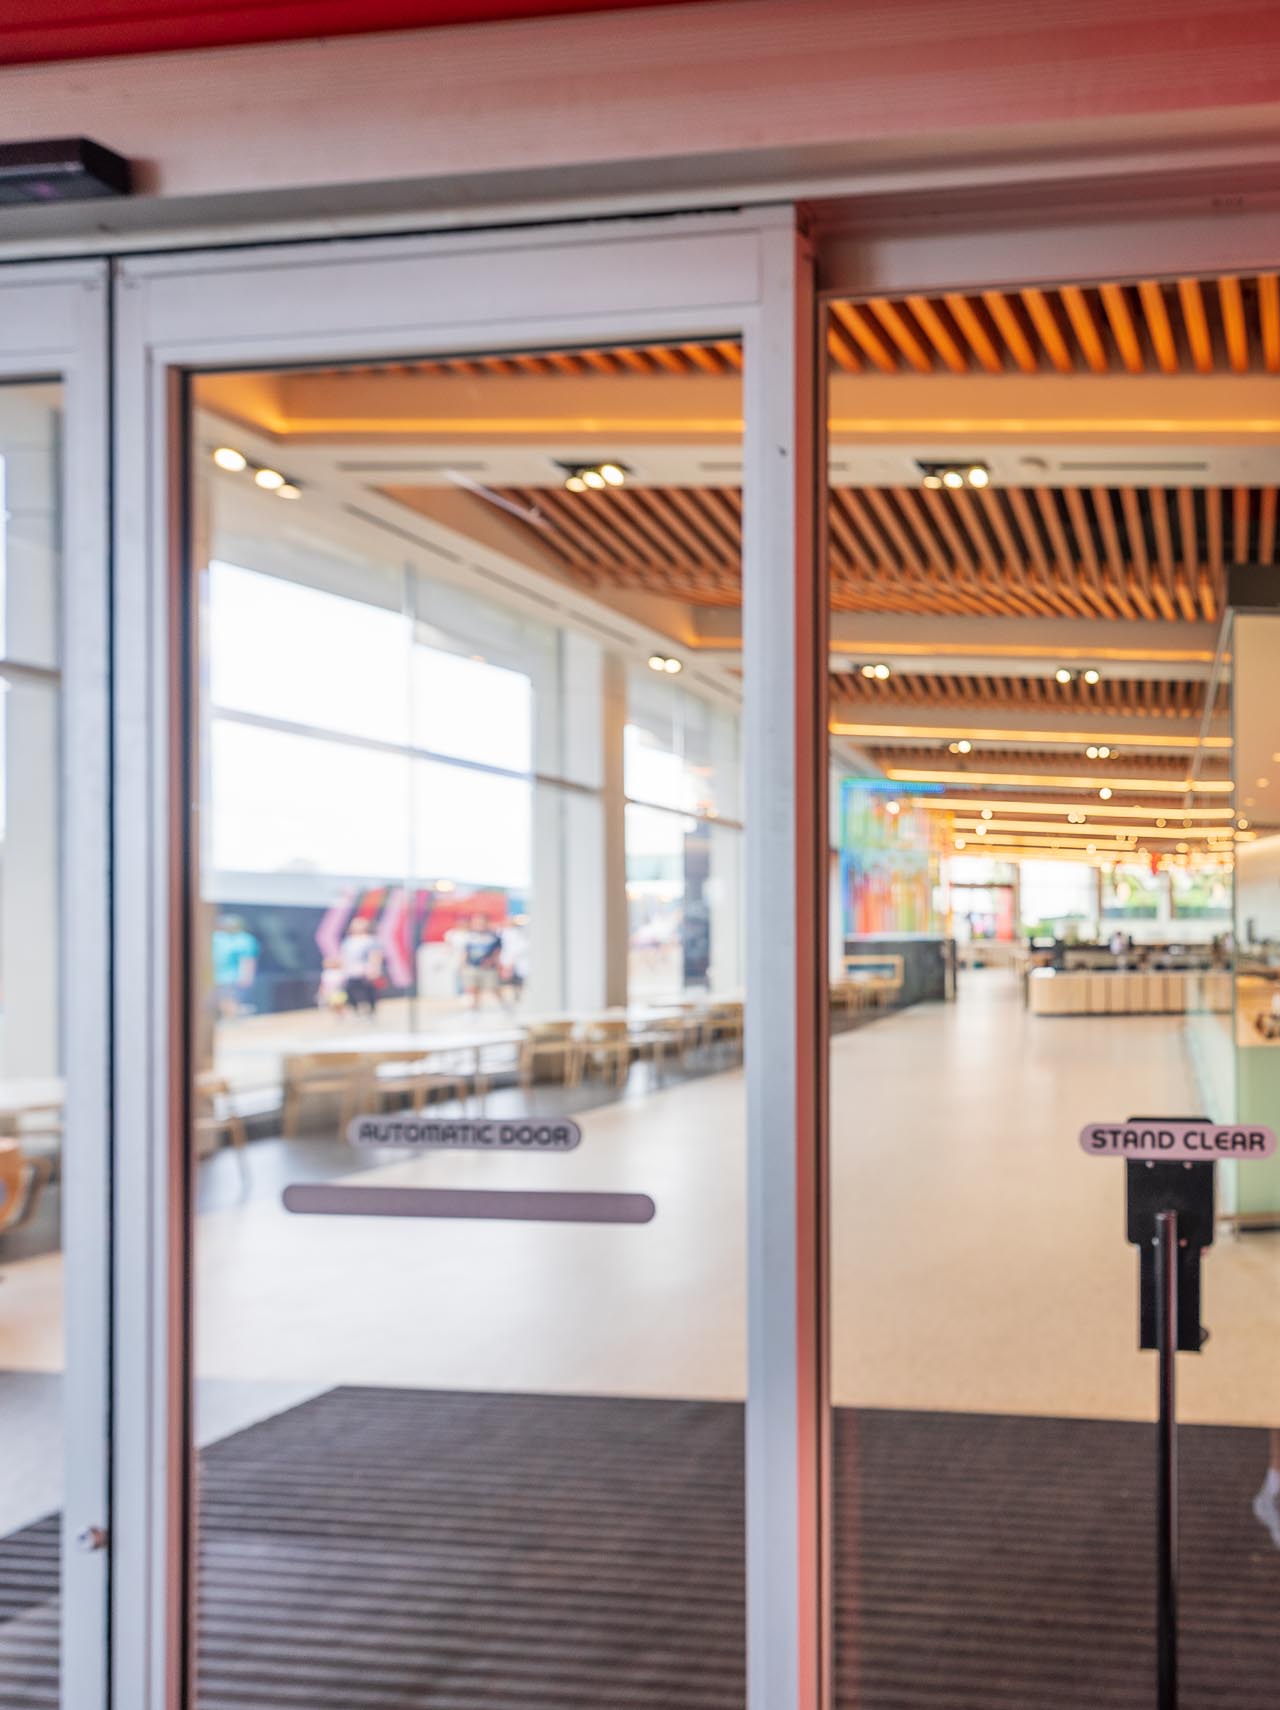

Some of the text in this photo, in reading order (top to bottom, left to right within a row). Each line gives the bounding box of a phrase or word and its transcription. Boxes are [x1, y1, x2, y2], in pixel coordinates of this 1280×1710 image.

[359, 1123, 570, 1145] AUTOMATIC DOOR
[1091, 1129, 1266, 1151] STAND CLEAR
